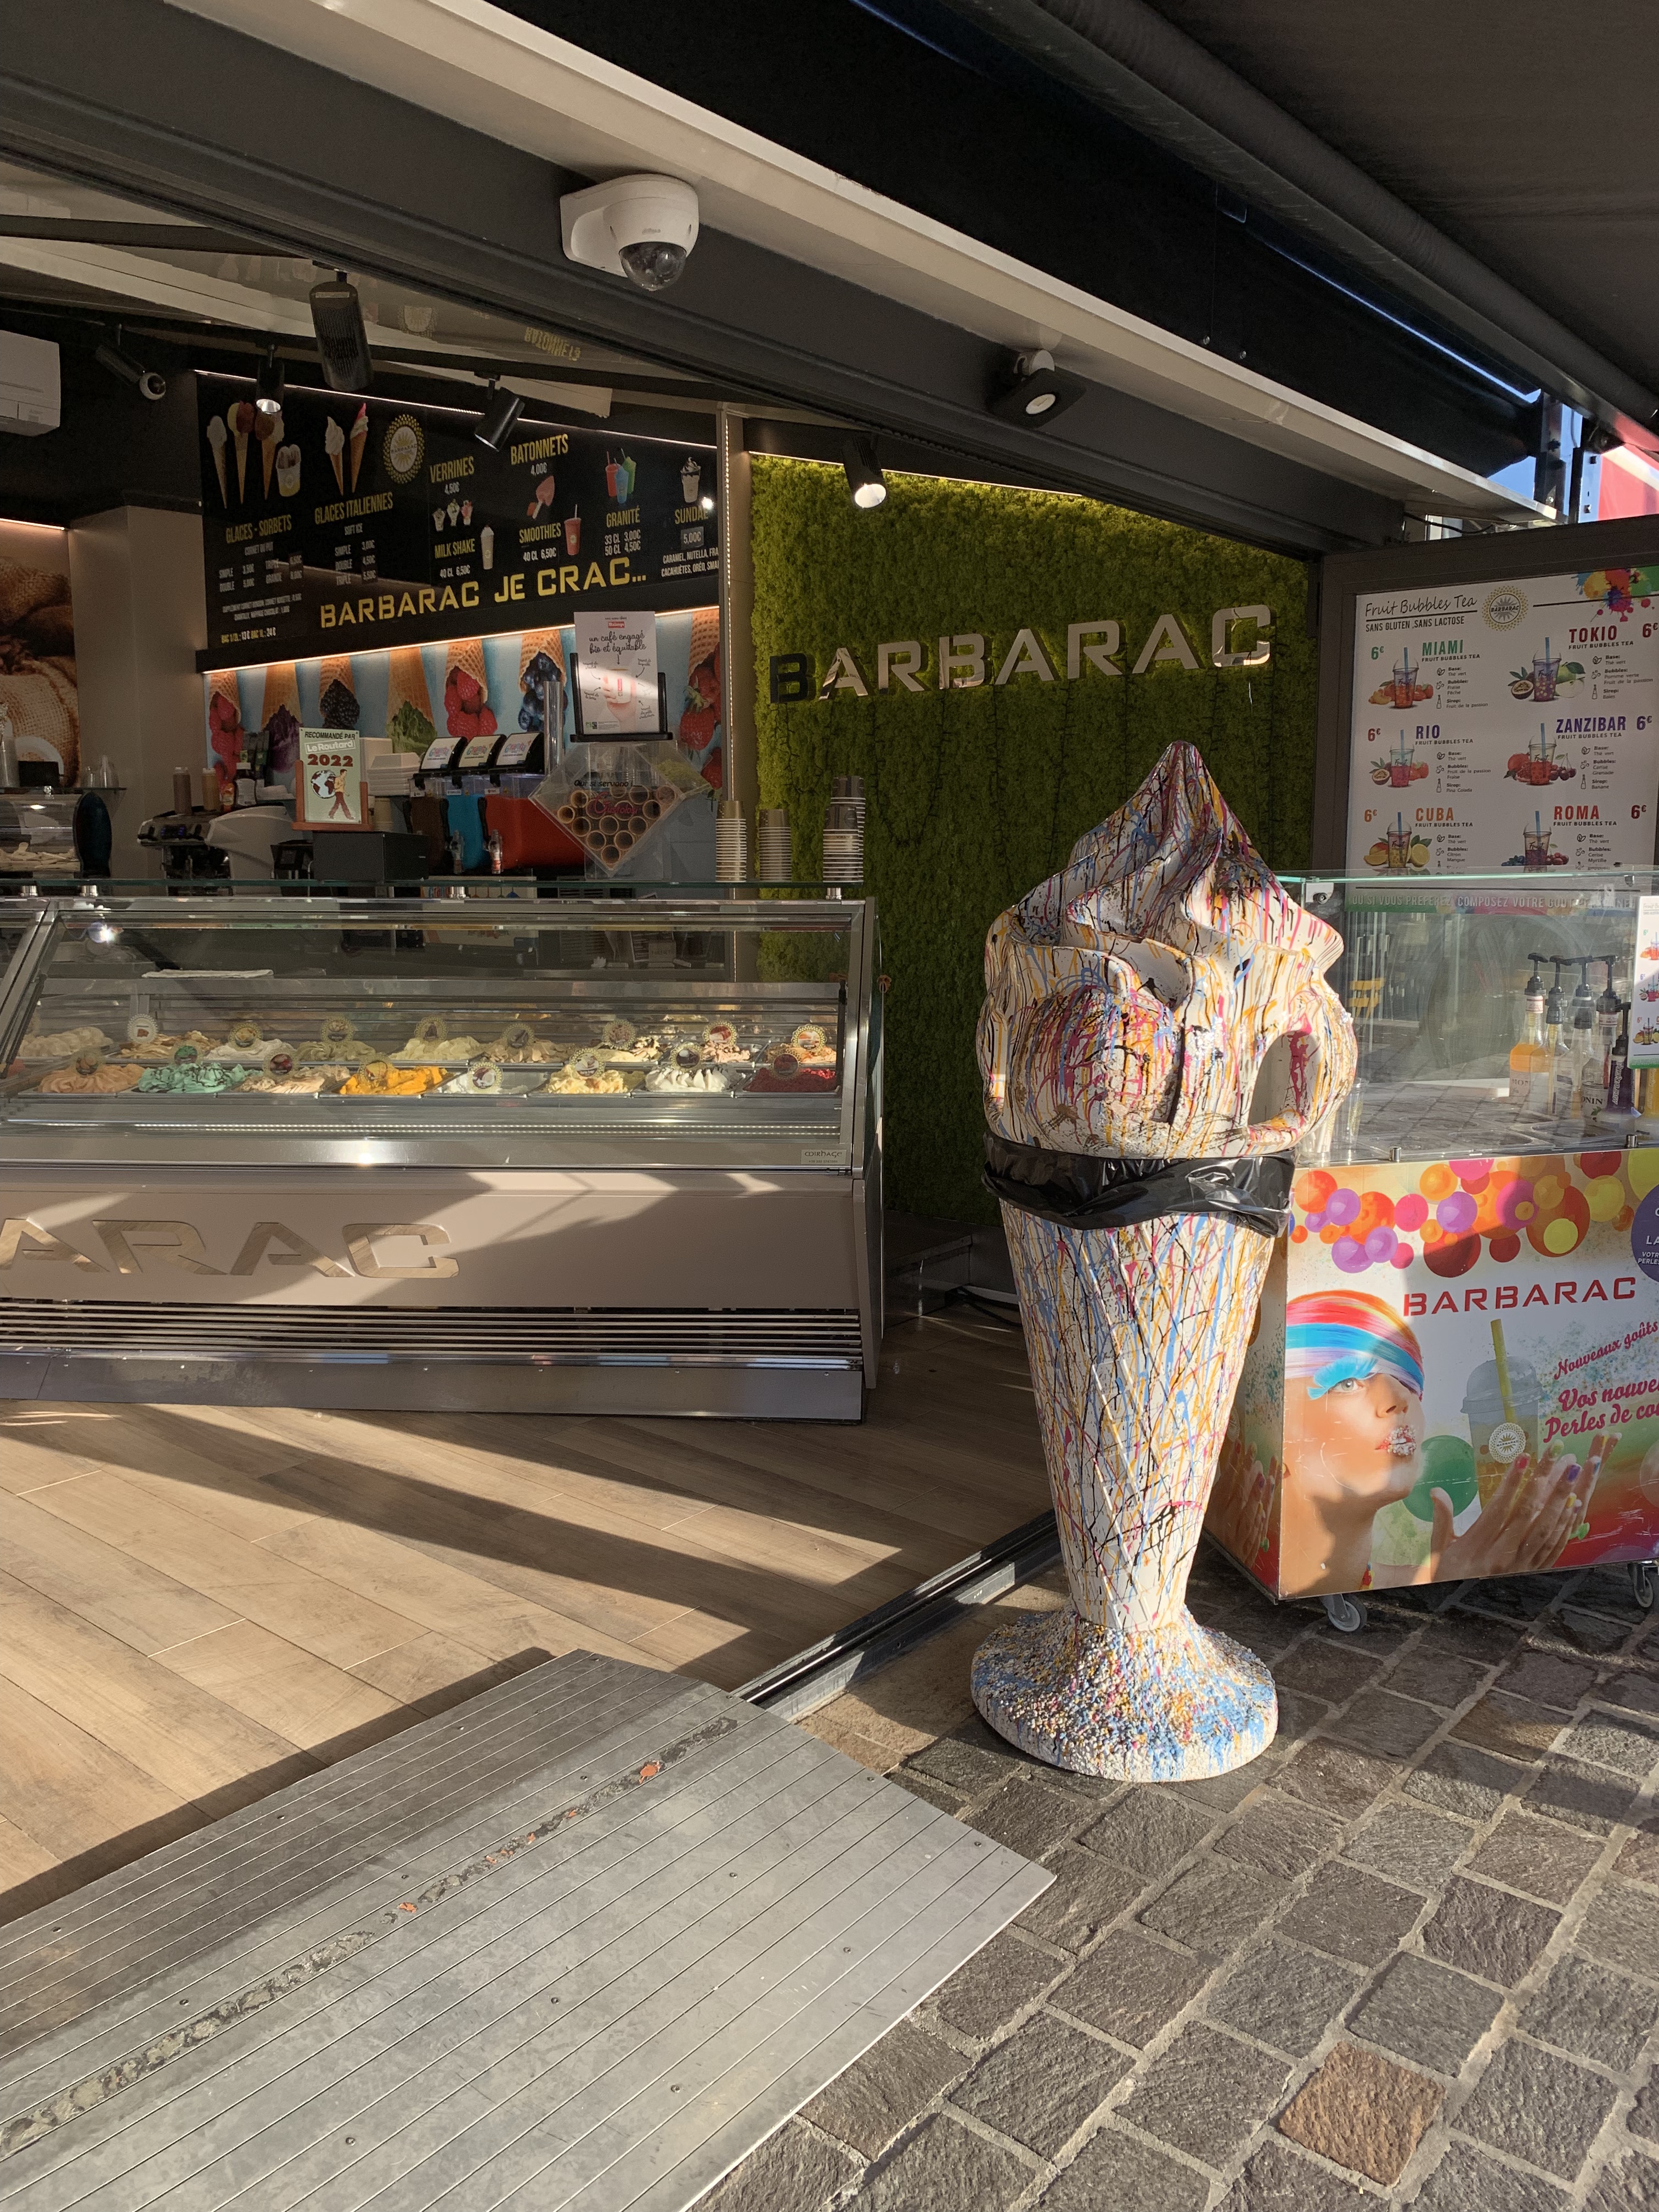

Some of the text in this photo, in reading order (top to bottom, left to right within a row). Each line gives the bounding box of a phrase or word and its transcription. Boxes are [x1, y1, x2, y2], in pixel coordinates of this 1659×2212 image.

[510, 433, 568, 465] BATONNETS
[430, 456, 475, 483] VERRINES
[315, 492, 393, 524] GLACES ITALIENNES
[606, 505, 641, 528] GRANITÉ
[226, 514, 292, 544] GLACES SORBETS
[519, 522, 562, 544] SMOOTHIES
[605, 534, 612, 545] 33
[613, 533, 620, 543] CL
[435, 538, 476, 559] MILK SHAKE
[320, 581, 479, 629] BARBARAC
[494, 573, 526, 603] JE
[1365, 595, 1477, 617] Fruit Bubbles Tea
[1366, 623, 1383, 632] SANS
[1385, 620, 1410, 630] GLUTEN
[1435, 616, 1465, 627] LACTOSE
[1642, 623, 1658, 638] 6€
[601, 631, 617, 644] café
[619, 630, 645, 642] engagé
[1569, 625, 1618, 643] TOKIO
[590, 639, 647, 655] bio et équitable
[769, 604, 1272, 704] BARBARAC
[1371, 646, 1384, 659] 6€
[1422, 640, 1464, 656] MIAMI
[1556, 716, 1626, 733] ZANZIBAR
[1637, 715, 1652, 731] 6€
[1368, 728, 1381, 741] 6€
[1415, 725, 1440, 739] RIO
[307, 754, 353, 767] 2022
[1364, 809, 1378, 822] 6€
[1415, 808, 1454, 821] CUBA
[1554, 805, 1600, 820] ROMA
[1631, 805, 1647, 819] 6€
[1379, 896, 1403, 905] VOUS
[1458, 896, 1508, 907] COMPOSEZ
[1513, 897, 1545, 908] VOTRE
[1404, 1277, 1636, 1317] BARBARAC
[1554, 1321, 1658, 1380] Nouveaux goûts
[1559, 1378, 1659, 1412] Vos nouve
[1543, 1403, 1633, 1443] Perles de
